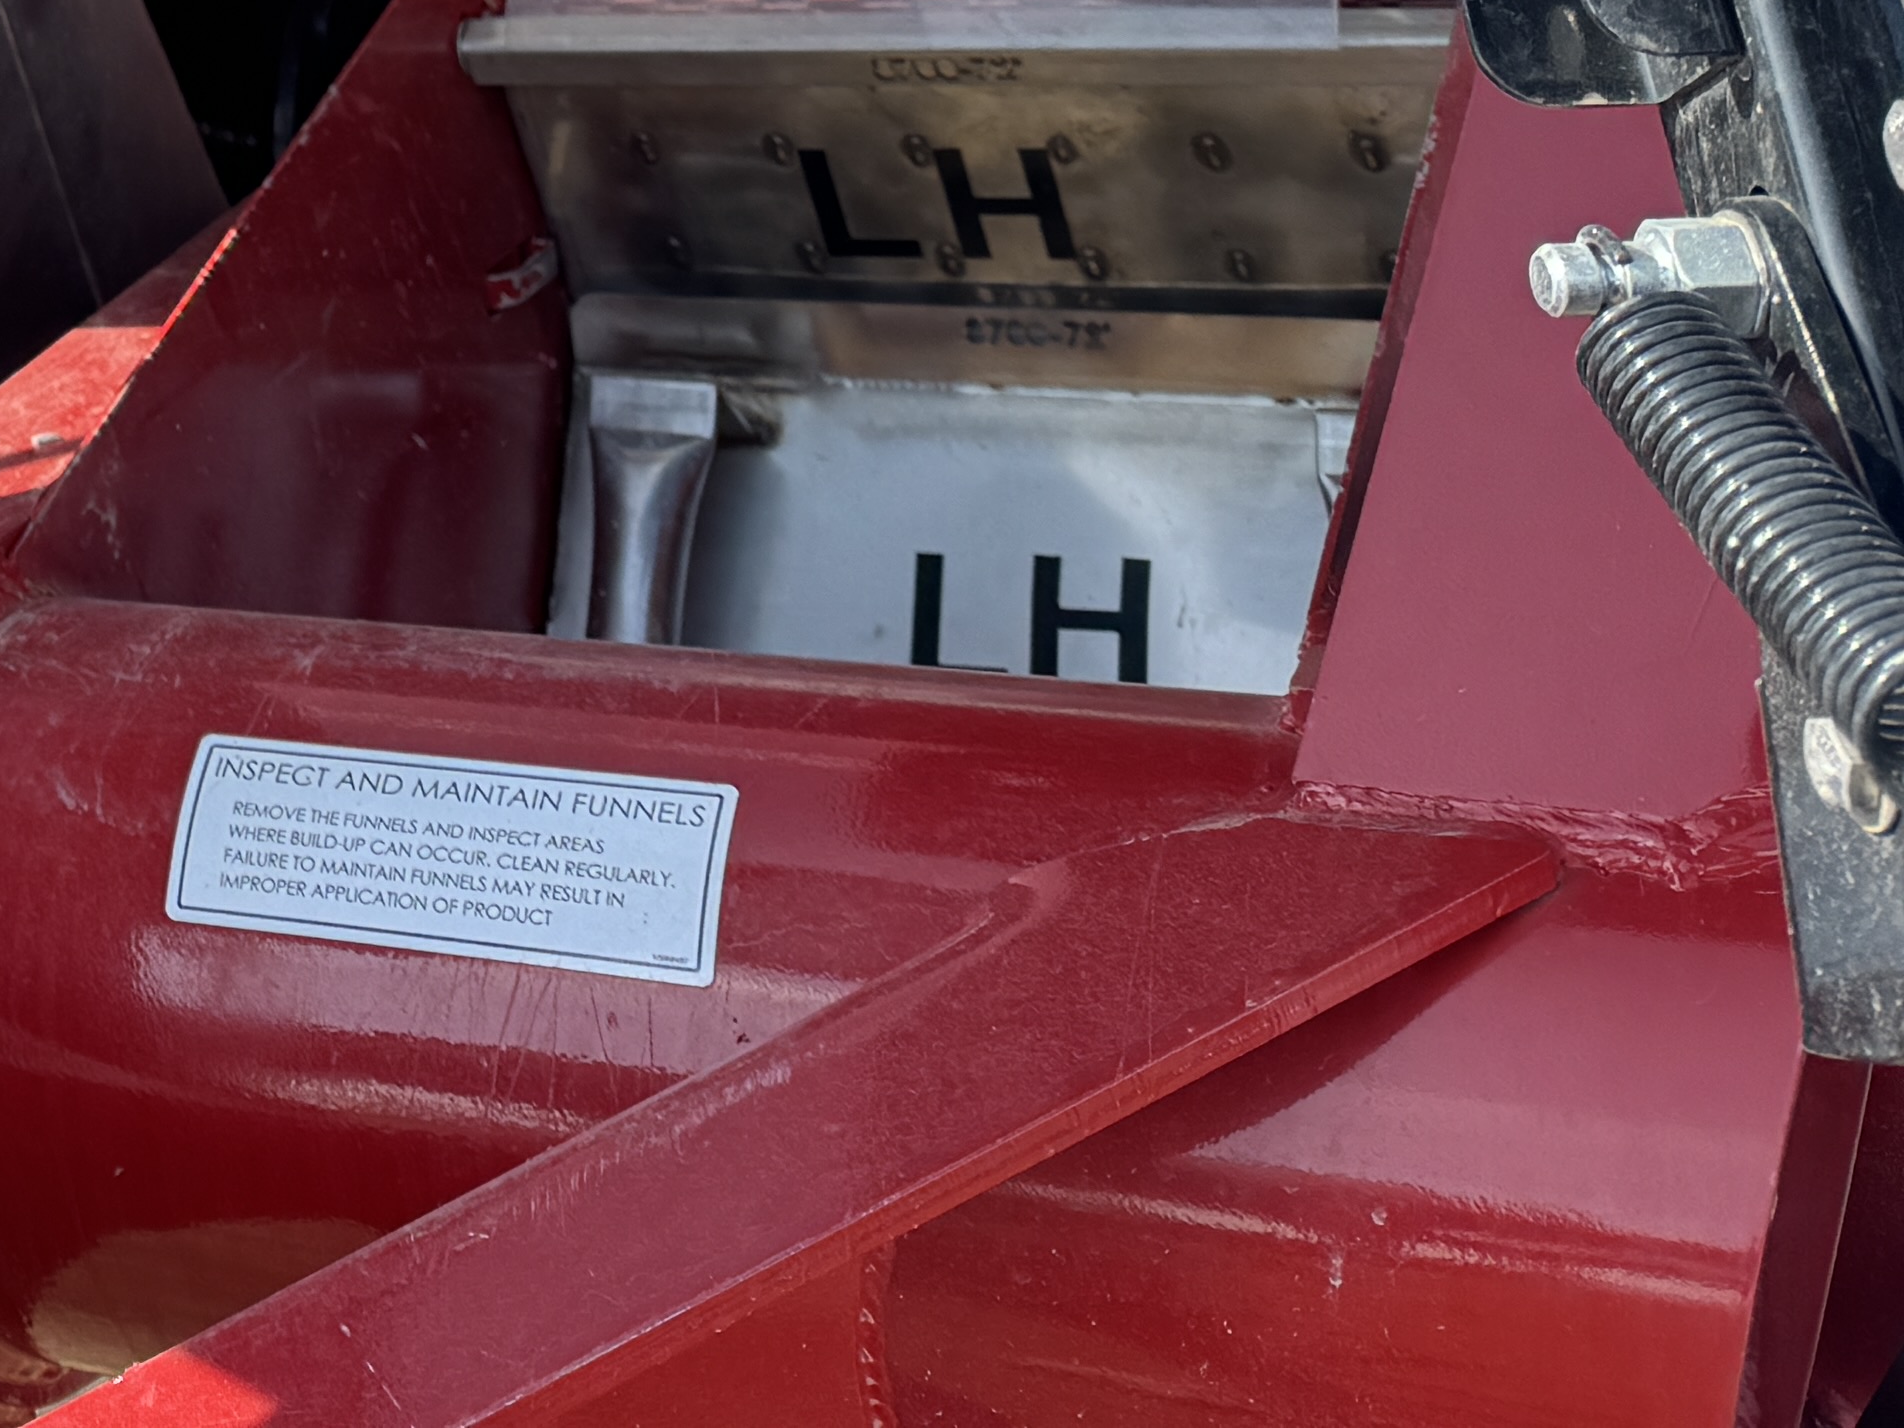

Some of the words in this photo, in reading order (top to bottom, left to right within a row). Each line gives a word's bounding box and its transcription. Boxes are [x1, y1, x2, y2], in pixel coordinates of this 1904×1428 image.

[797, 148, 1077, 260] LH
[911, 552, 1152, 684] LH
[215, 757, 330, 788] INSPECT
[334, 771, 403, 795] AND
[411, 778, 562, 812] MAINTAIN
[572, 792, 706, 827] FUNNELS
[229, 824, 287, 845] WHERE
[290, 831, 366, 852] BUILD-UP
[369, 840, 413, 858] CAN
[417, 844, 491, 867] OCCUR.
[496, 853, 559, 874] CLEAN
[564, 860, 675, 889] REGULARLY.
[232, 801, 306, 823] REMOVE
[311, 808, 340, 826] THE
[343, 813, 418, 834] FUNNELS
[422, 822, 464, 839] AND
[468, 826, 541, 847] INSPECT
[545, 835, 605, 854] AREAS
[220, 872, 307, 898] IMPROPER
[311, 884, 427, 911] APPLICATION
[432, 897, 459, 915] OF
[462, 900, 553, 926] PRODUCT
[223, 848, 289, 870] FAILURE
[293, 855, 316, 872] TO
[320, 858, 406, 882] MAINTAIN
[410, 869, 487, 892] FUNNELS
[492, 879, 536, 897] MAY
[540, 883, 601, 906] RESULT
[606, 891, 625, 908] IN
